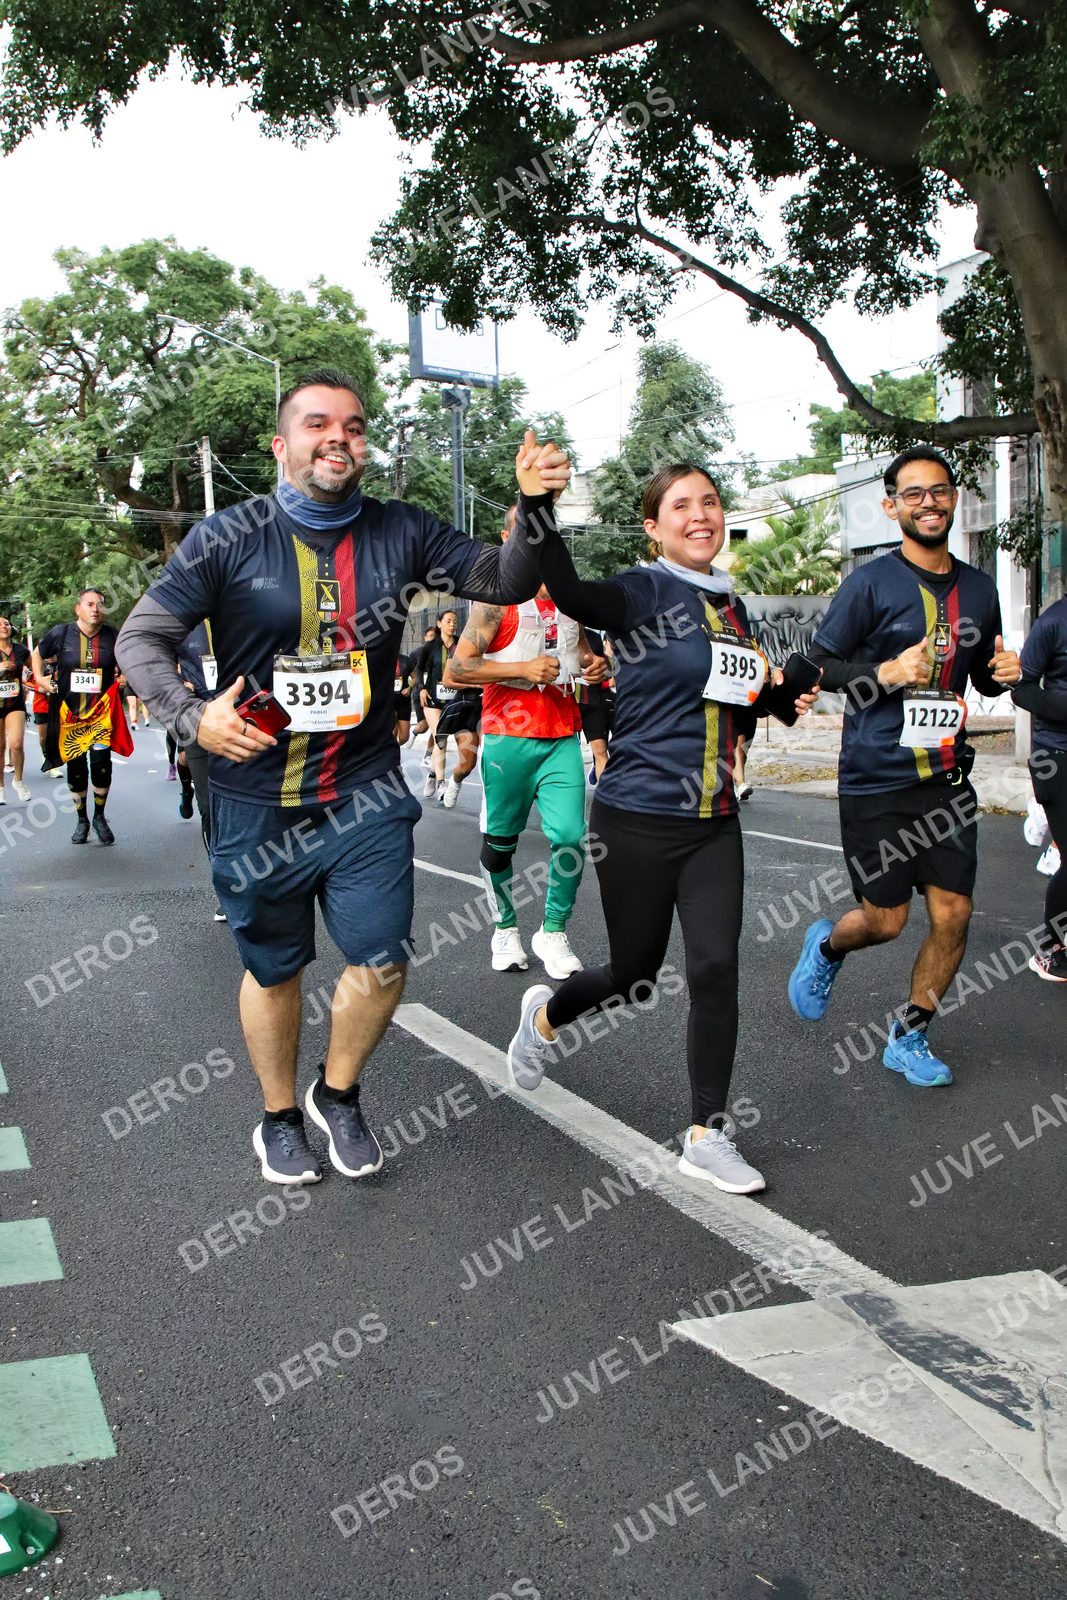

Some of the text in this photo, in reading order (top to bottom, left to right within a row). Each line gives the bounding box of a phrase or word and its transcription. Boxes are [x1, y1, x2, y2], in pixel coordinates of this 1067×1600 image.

[720, 651, 757, 680] 3395
[75, 676, 95, 684] 3341
[286, 680, 350, 706] 3394
[908, 707, 959, 728] 12122
